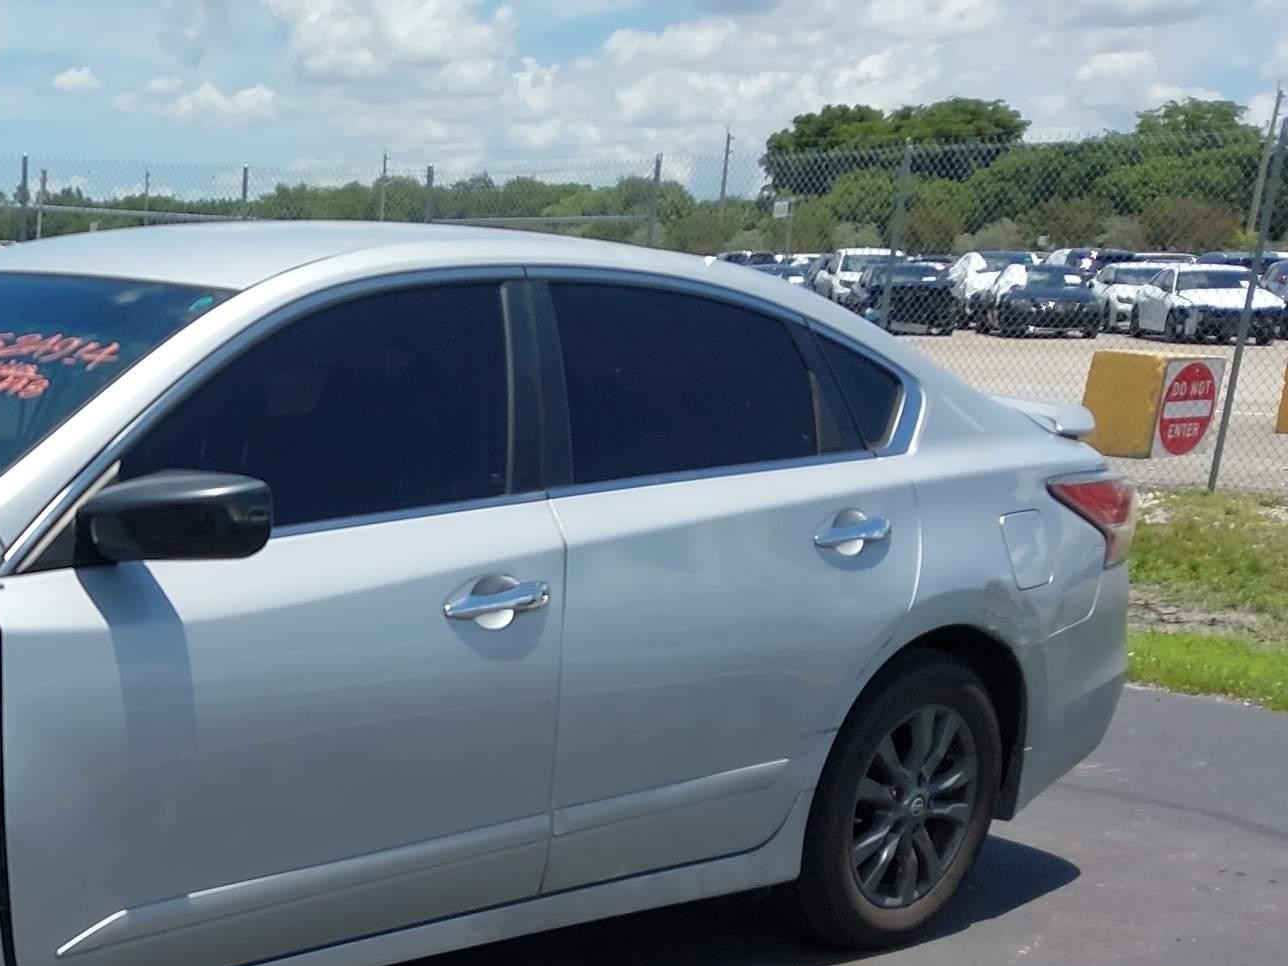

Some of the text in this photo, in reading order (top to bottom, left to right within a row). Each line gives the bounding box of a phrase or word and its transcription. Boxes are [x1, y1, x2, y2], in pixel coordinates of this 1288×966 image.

[1173, 381, 1212, 396] DO NOT
[1168, 423, 1199, 438] ENTER
